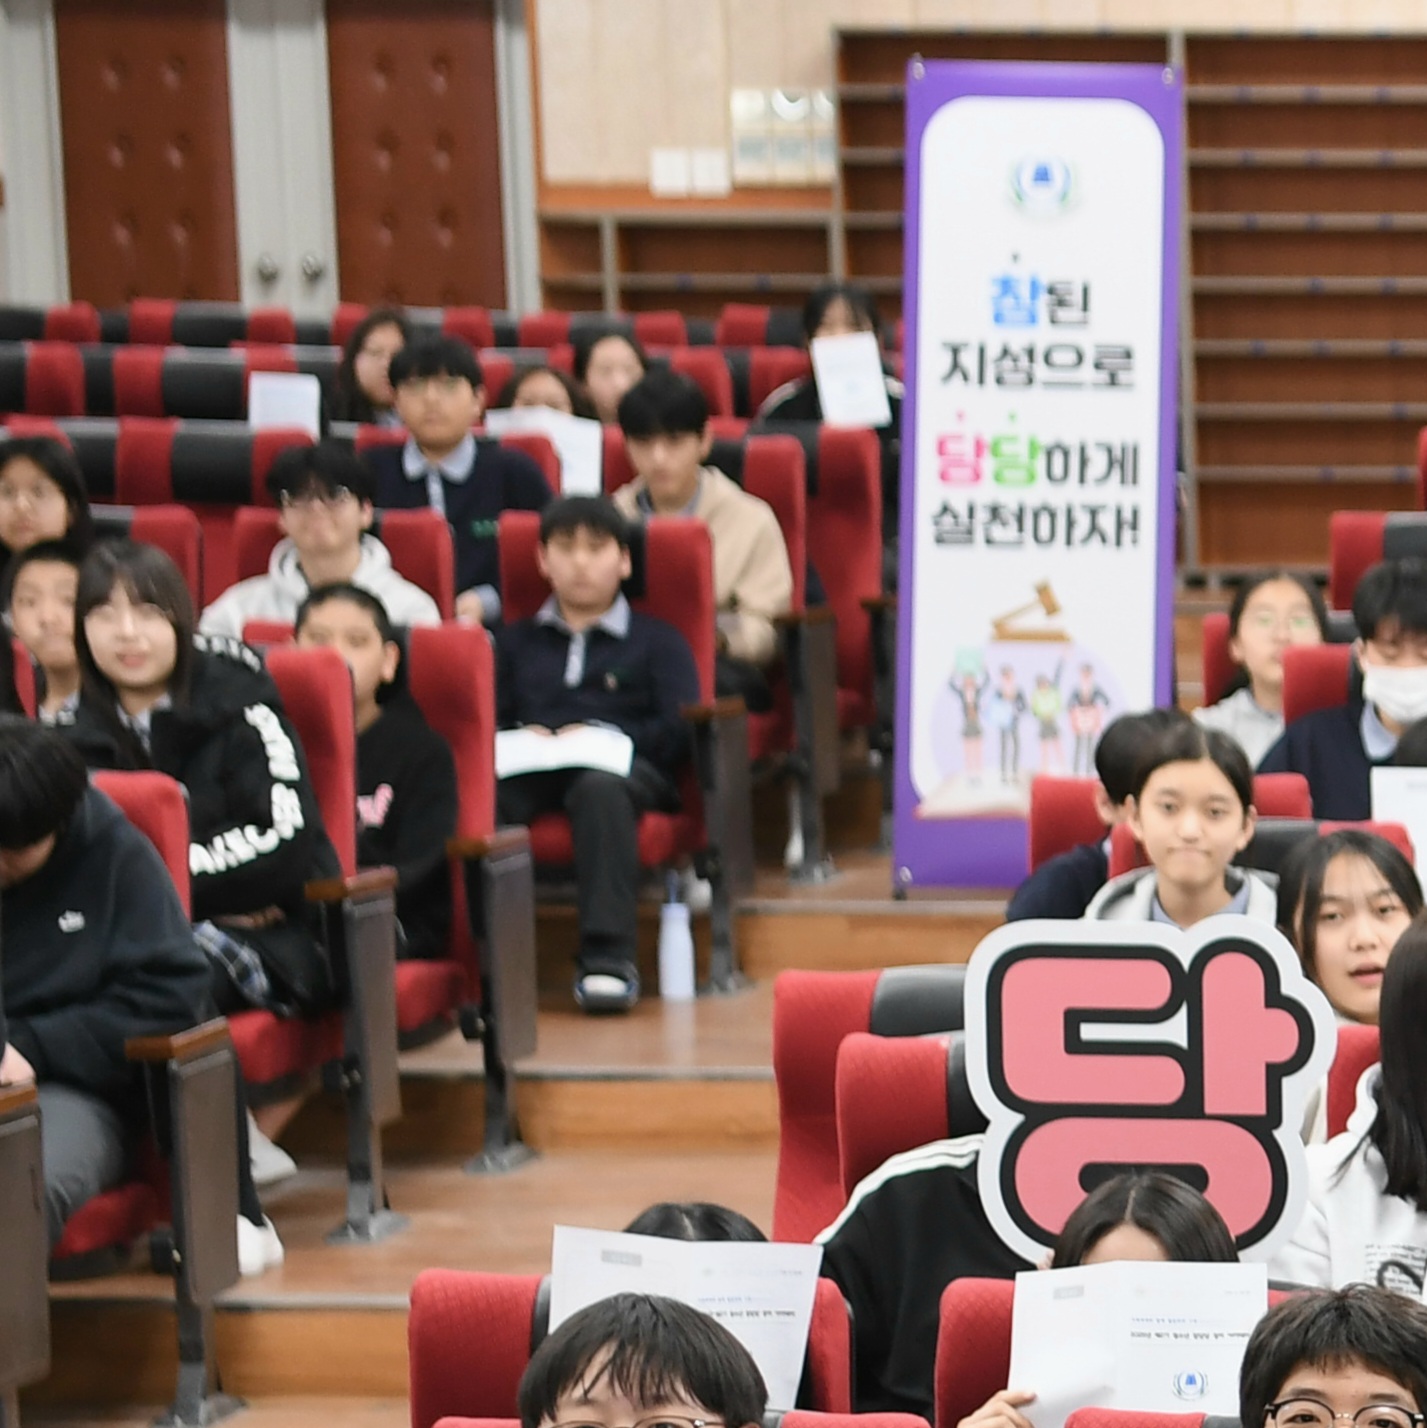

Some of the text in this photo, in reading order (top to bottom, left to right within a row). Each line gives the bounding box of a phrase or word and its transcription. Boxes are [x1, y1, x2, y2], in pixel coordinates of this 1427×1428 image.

[991, 275, 1090, 326] 참된
[941, 341, 1134, 388] 지성으로
[936, 434, 1139, 487] 당당하게
[931, 500, 1139, 548] 실천하자!
